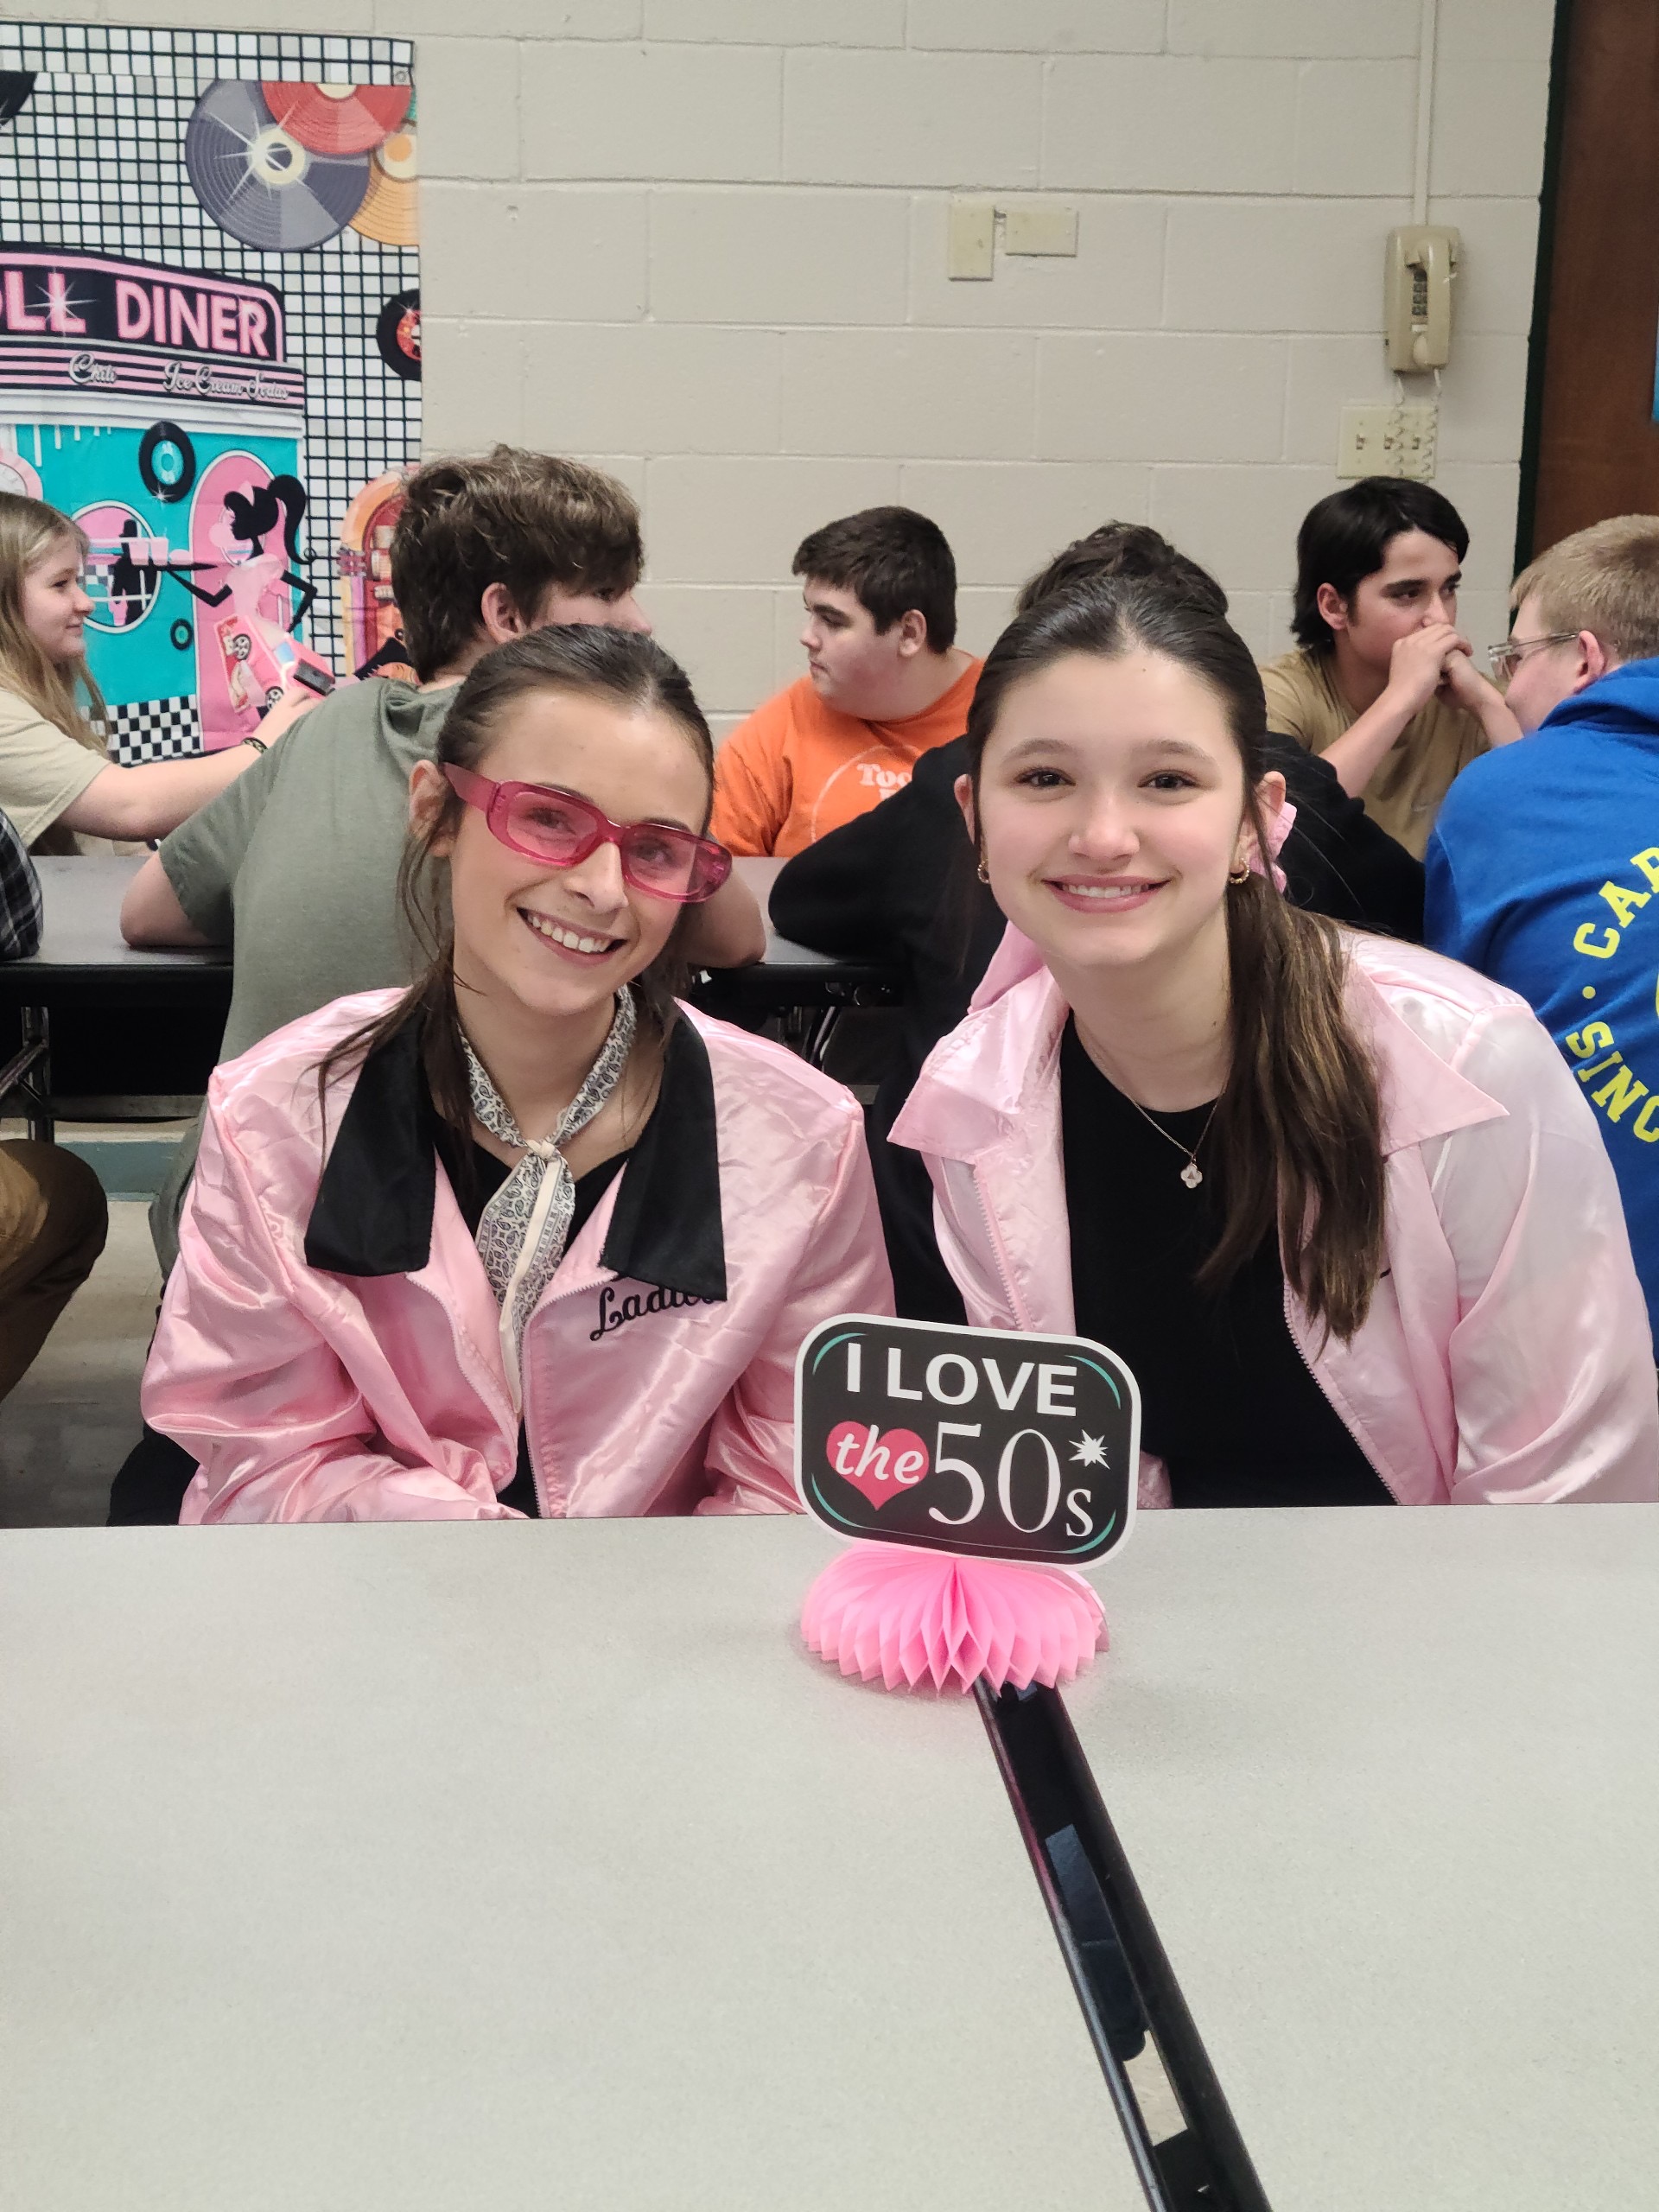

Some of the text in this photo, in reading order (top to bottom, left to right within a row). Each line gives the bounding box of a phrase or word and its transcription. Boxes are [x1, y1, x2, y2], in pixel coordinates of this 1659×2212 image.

[0, 270, 270, 357] LL DINER
[163, 360, 289, 399] Ice Cream Sodas
[589, 1287, 715, 1341] Ladi
[847, 1343, 1077, 1417] I LOVE
[836, 1424, 924, 1484] the
